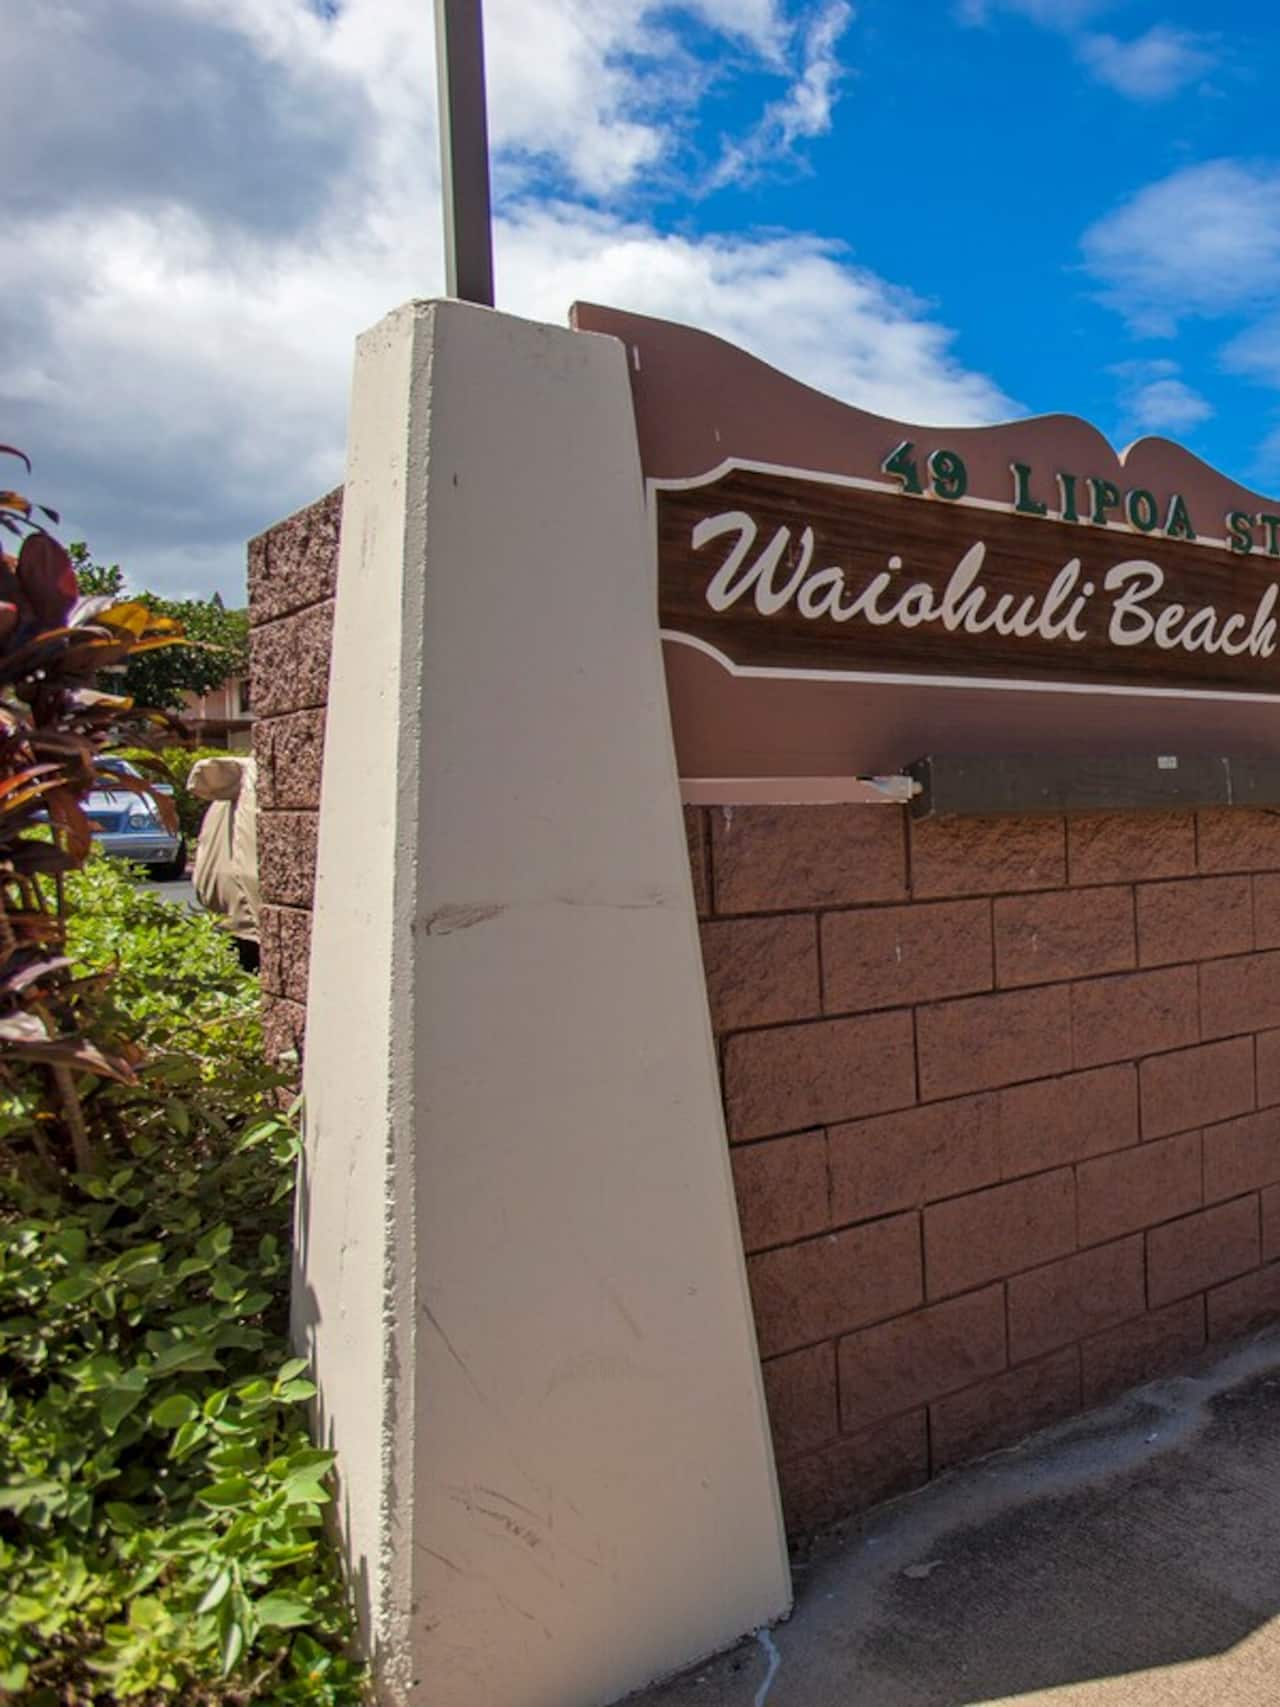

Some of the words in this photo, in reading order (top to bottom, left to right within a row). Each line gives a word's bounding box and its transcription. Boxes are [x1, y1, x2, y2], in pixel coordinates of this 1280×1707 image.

[881, 441, 968, 500] 49
[1009, 462, 1197, 542] LIPOA
[691, 510, 1095, 642] Waiohuli
[1104, 560, 1279, 659] Beach
